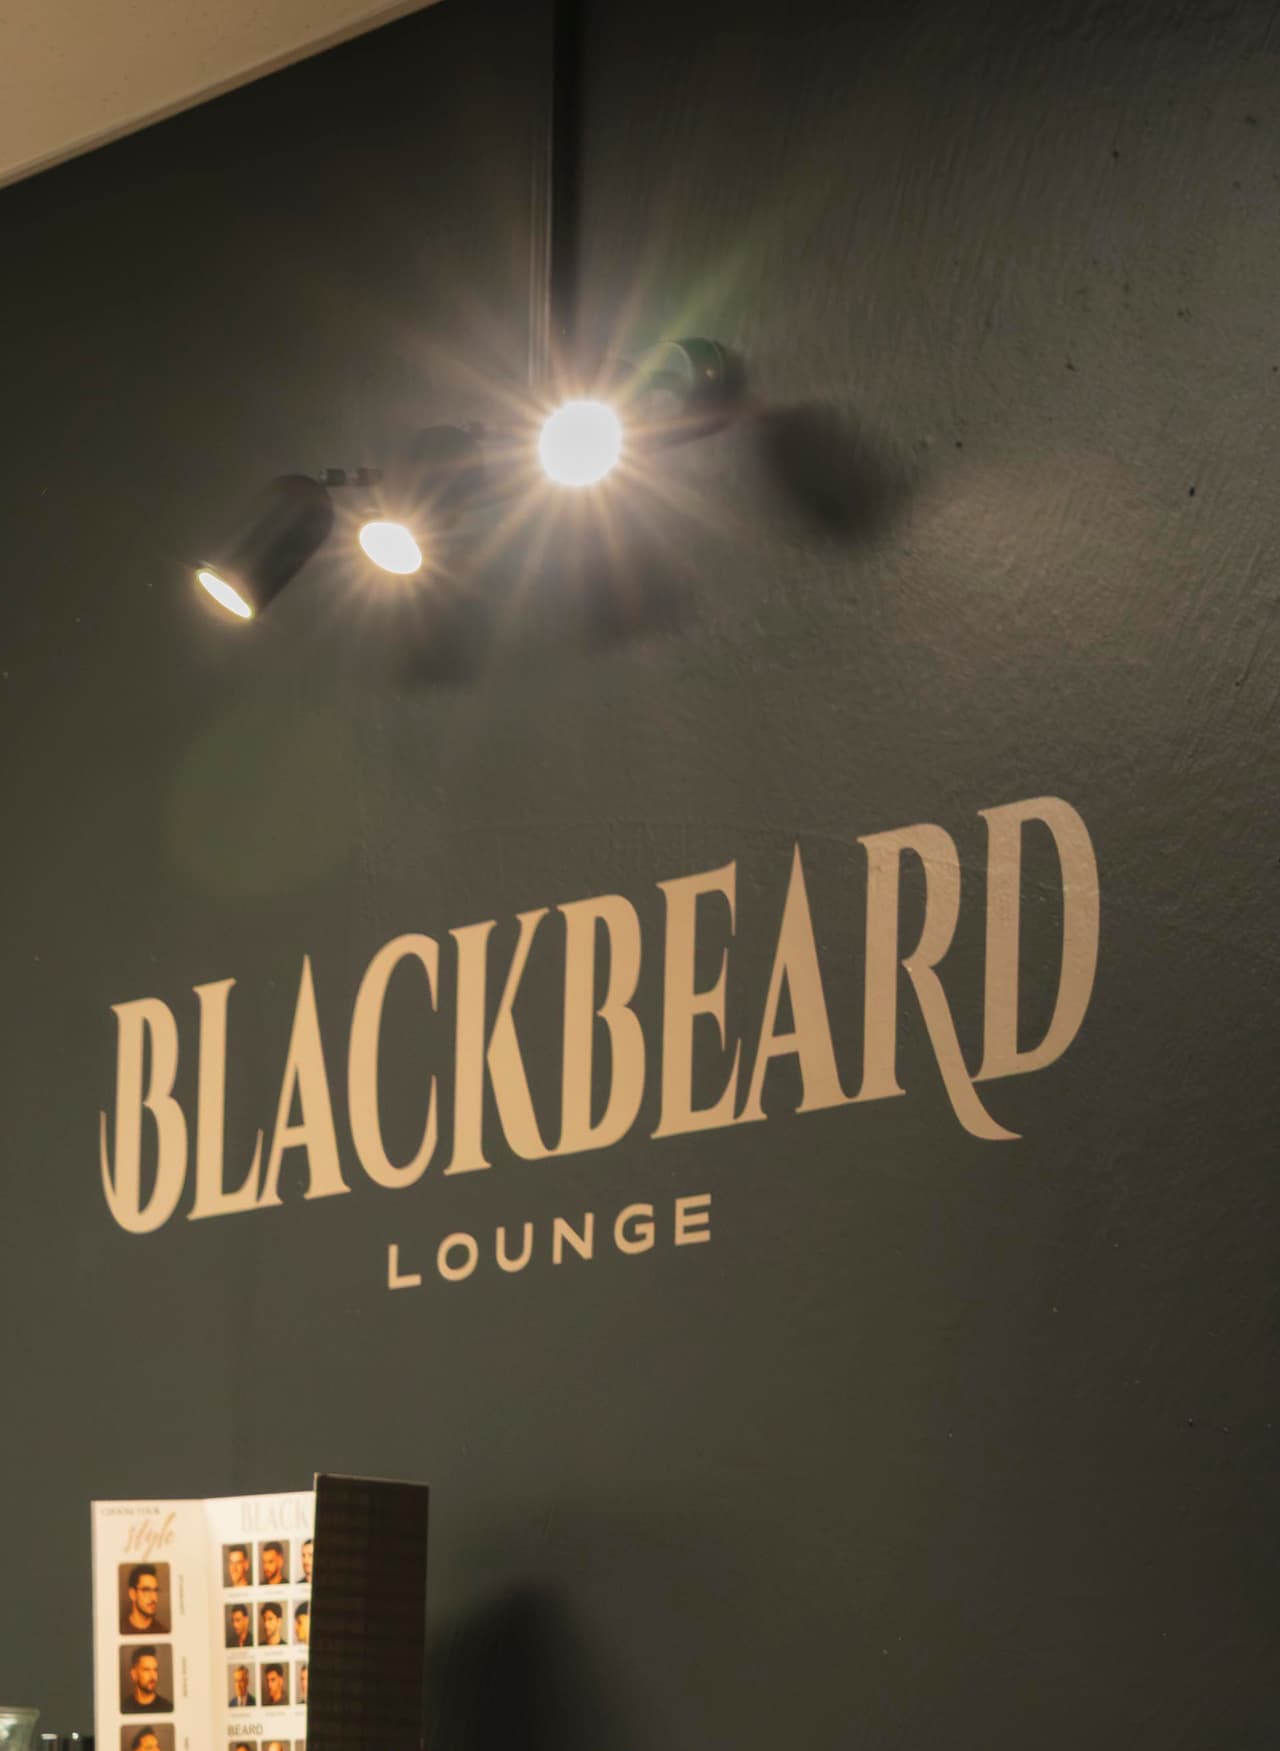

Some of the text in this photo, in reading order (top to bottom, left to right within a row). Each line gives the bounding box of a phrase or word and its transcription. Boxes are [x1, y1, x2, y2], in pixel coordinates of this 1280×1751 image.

[99, 795, 1101, 1234] BLACKBEARD
[387, 1193, 712, 1290] LOUNGE
[228, 1724, 264, 1736] BEARD
